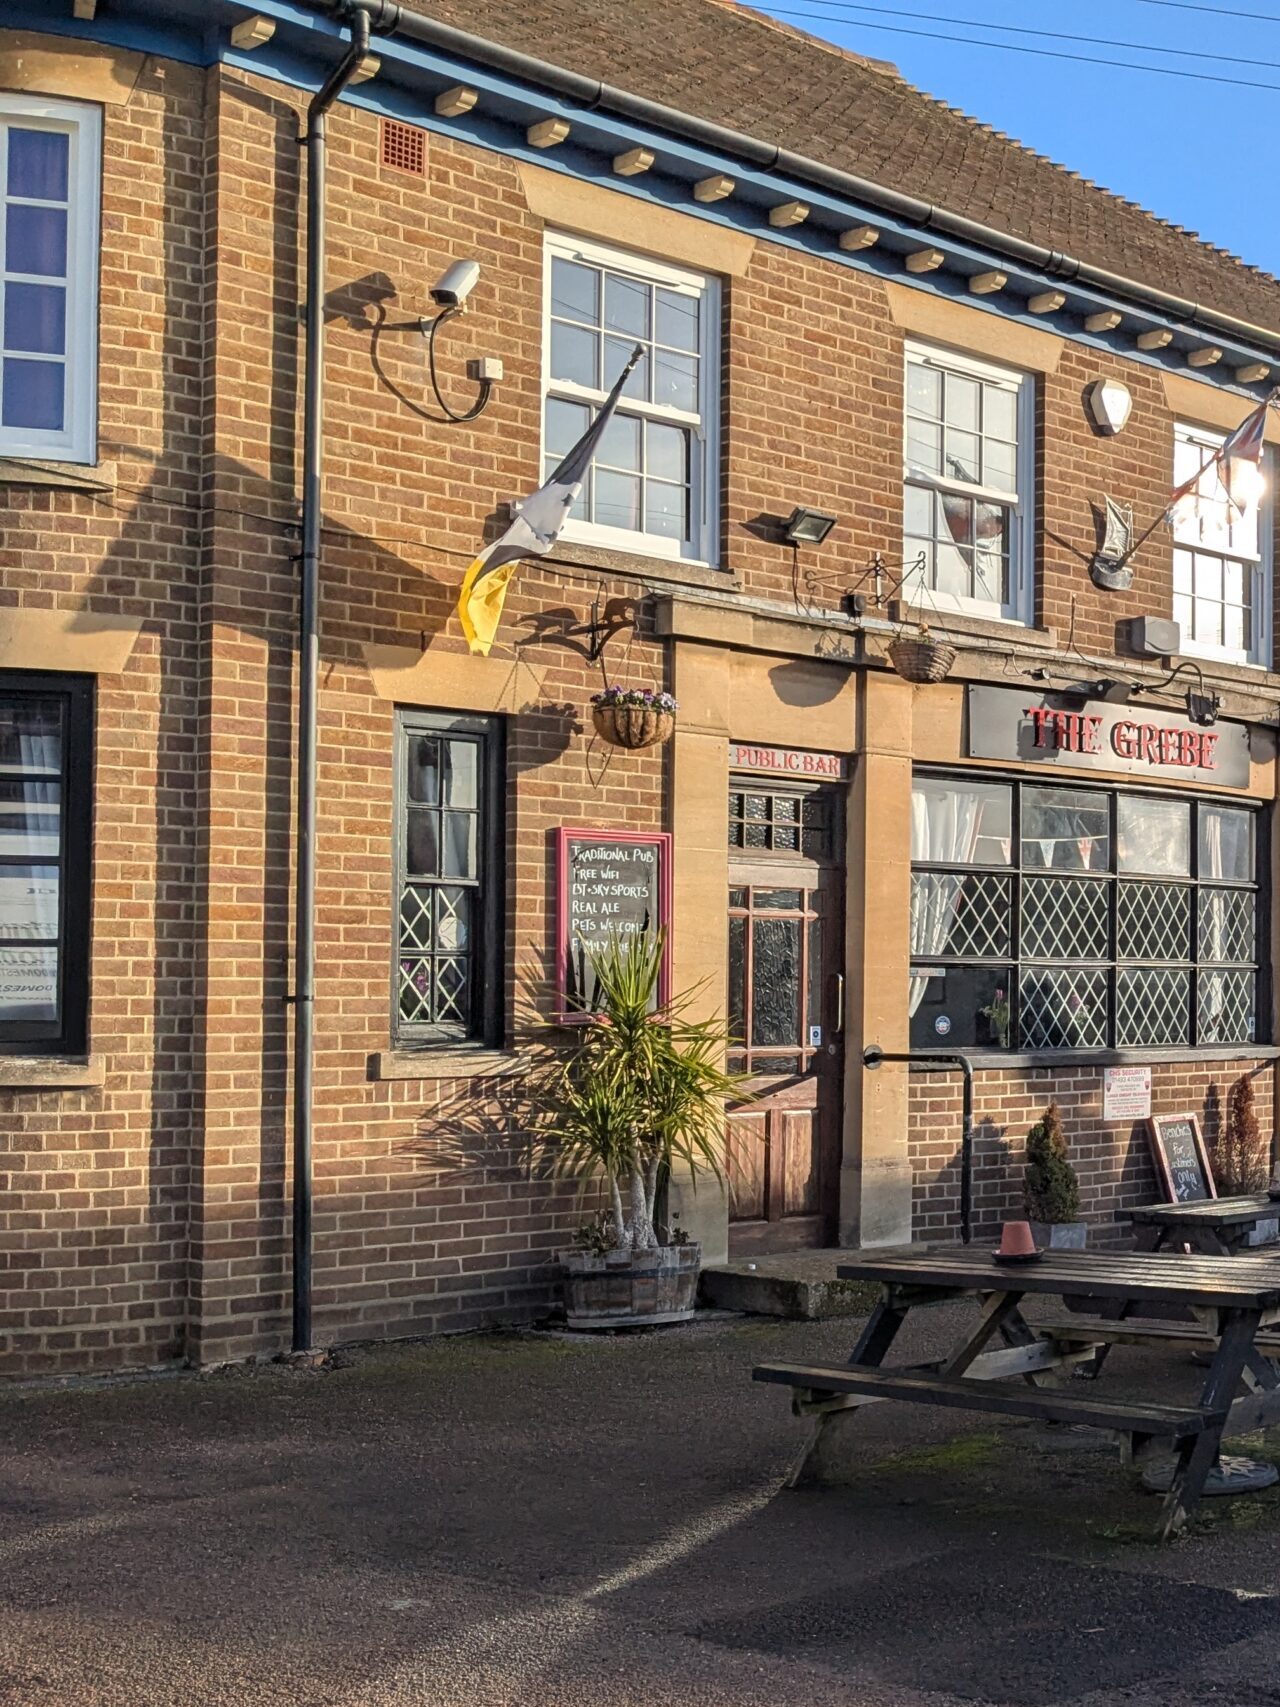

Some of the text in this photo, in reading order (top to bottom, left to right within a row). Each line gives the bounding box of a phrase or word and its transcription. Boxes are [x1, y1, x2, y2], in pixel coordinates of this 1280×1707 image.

[1028, 706, 1219, 769] THE GREBE
[736, 747, 840, 776] PUBLIC BAR
[571, 845, 654, 863] TRADITIONAL PUB
[573, 865, 597, 881] FREE
[572, 900, 620, 915] REAL ALE
[572, 918, 596, 932] PETS
[572, 939, 609, 955] FMILY
[1172, 1142, 1184, 1155] for
